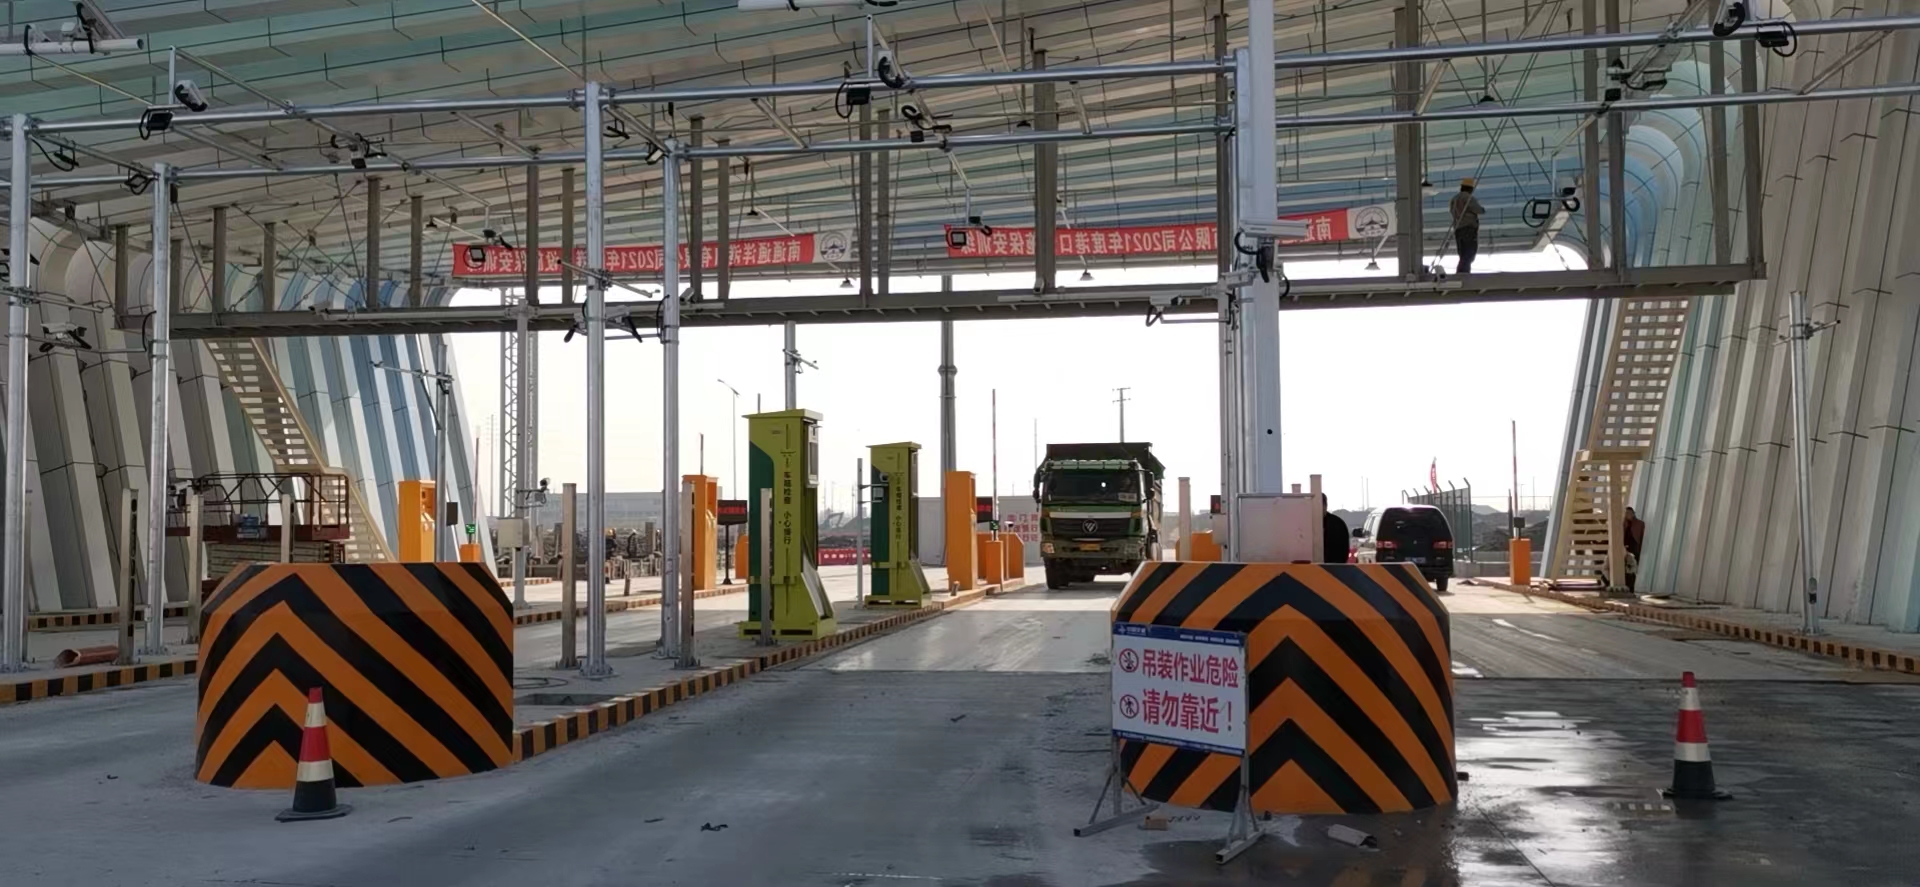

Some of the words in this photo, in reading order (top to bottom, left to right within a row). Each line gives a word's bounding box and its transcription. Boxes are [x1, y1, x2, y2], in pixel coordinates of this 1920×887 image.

[1142, 648, 1239, 688] 吊装作业危险
